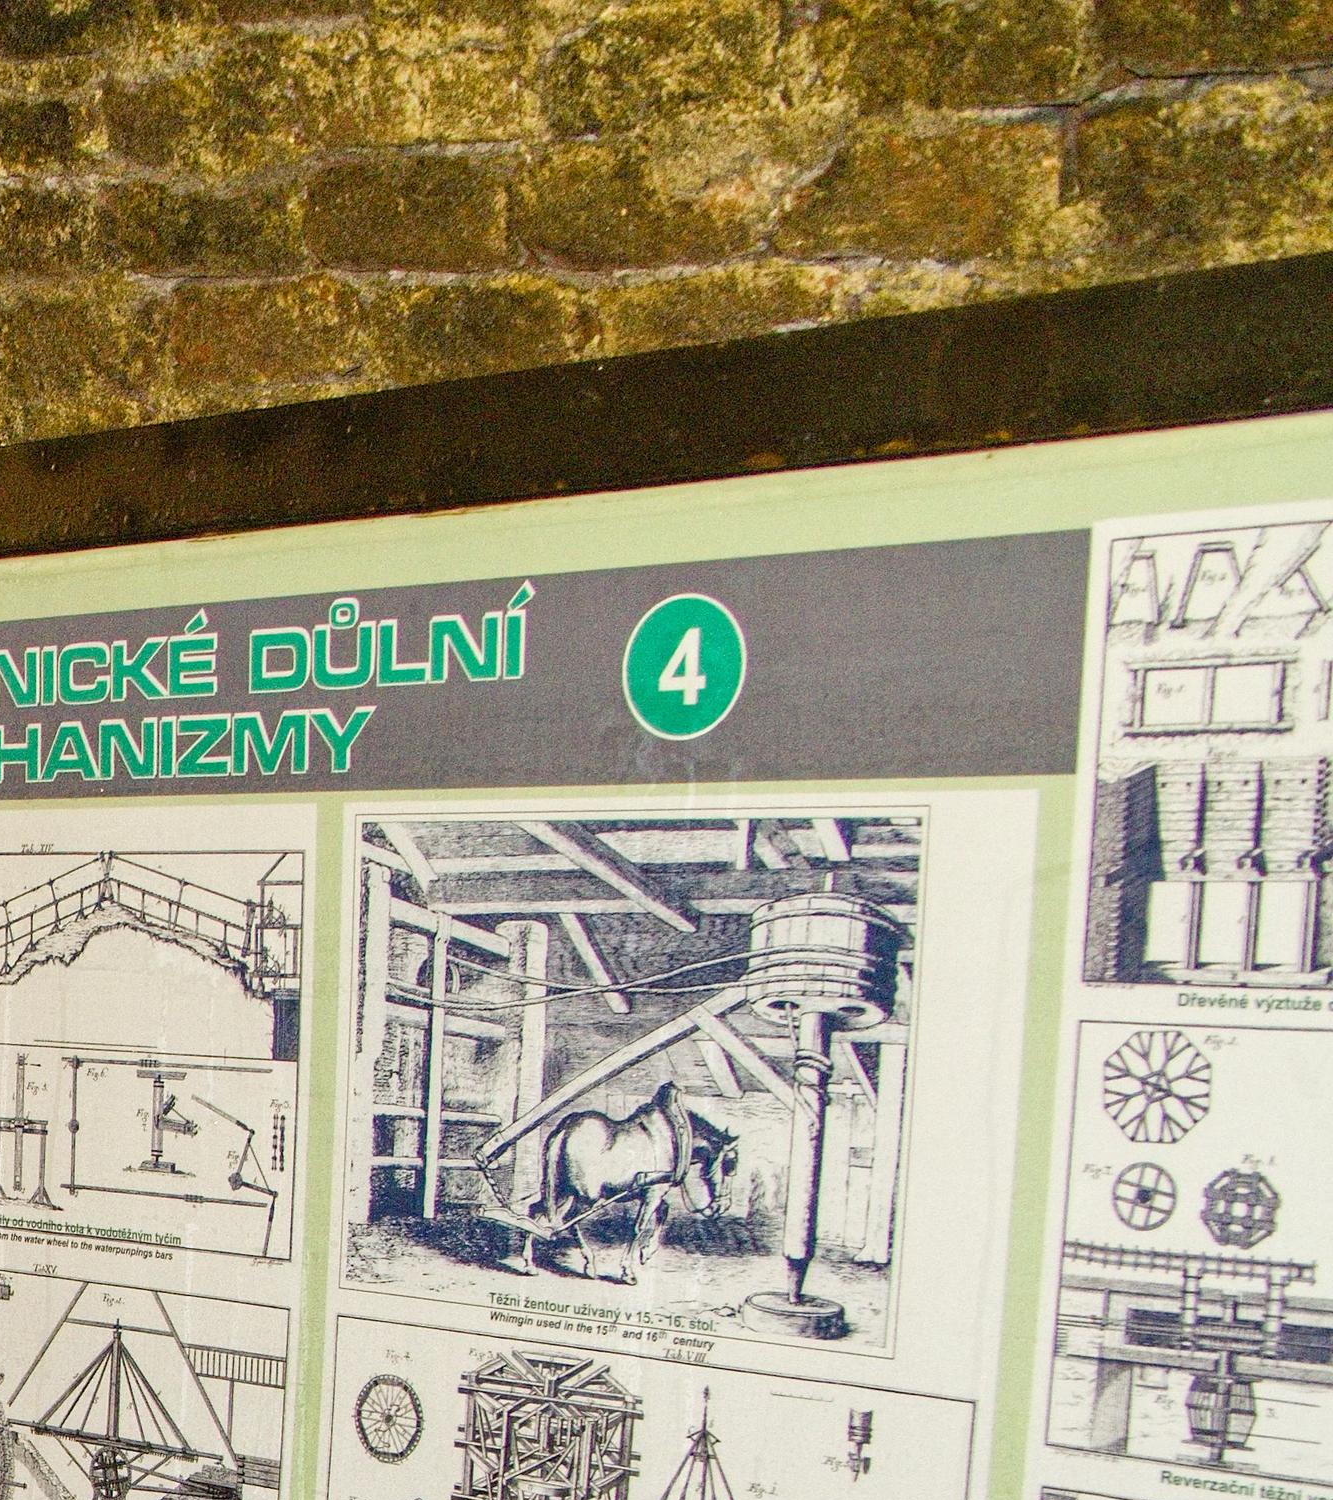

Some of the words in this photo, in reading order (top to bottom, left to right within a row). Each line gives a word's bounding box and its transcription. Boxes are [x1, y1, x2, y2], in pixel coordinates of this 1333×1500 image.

[248, 579, 536, 694] DŮLNÍ
[658, 627, 707, 705] 4
[1254, 994, 1322, 1013] výztuže
[13, 1217, 24, 1227] od
[65, 1222, 84, 1234] kola
[87, 1224, 94, 1234] k
[10, 1233, 22, 1243] the
[24, 1236, 44, 1245] water
[46, 1237, 69, 1248] wheel
[70, 1240, 79, 1249] to
[80, 1241, 92, 1251] the
[155, 1250, 173, 1261] bars
[523, 1297, 570, 1313] žentour
[625, 1312, 632, 1321] v
[489, 1311, 533, 1327] Whimgin
[536, 1318, 561, 1329] used
[563, 1321, 574, 1331] in
[576, 1323, 593, 1334] the
[622, 1329, 643, 1340] and
[673, 1337, 715, 1352] century
